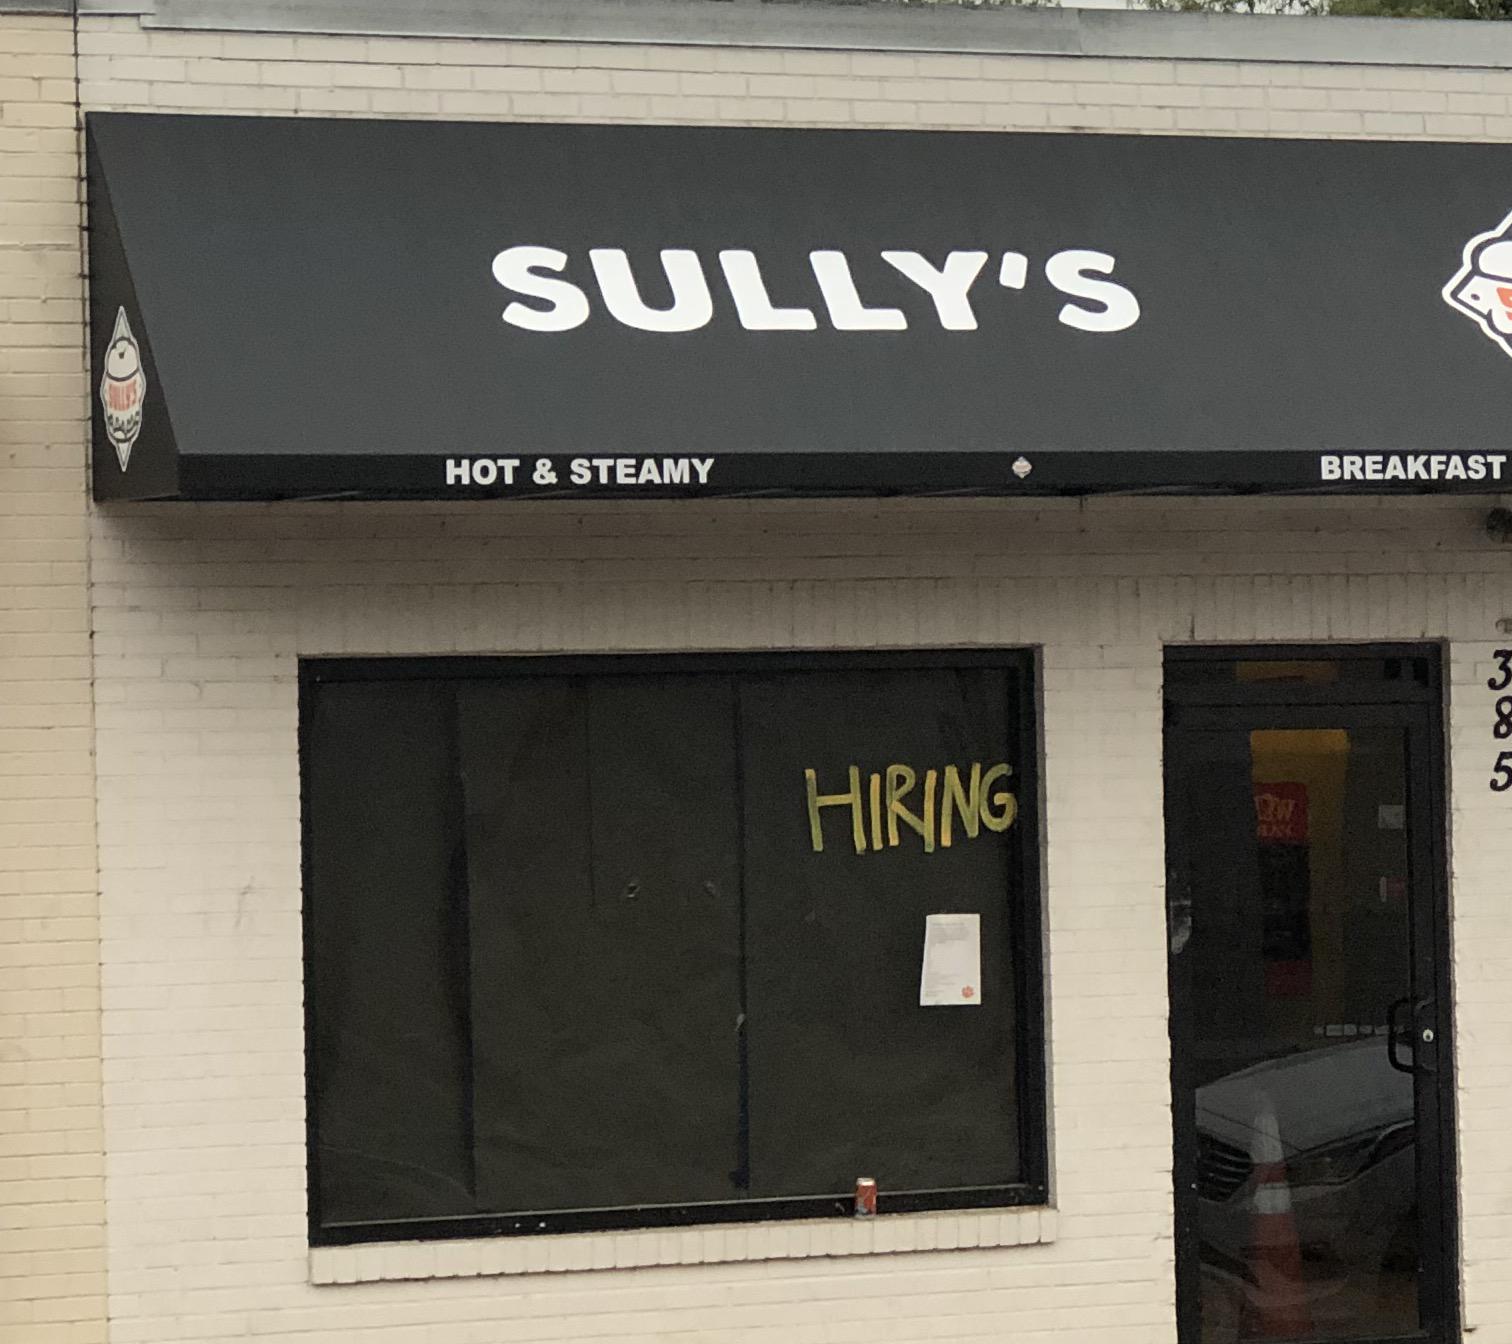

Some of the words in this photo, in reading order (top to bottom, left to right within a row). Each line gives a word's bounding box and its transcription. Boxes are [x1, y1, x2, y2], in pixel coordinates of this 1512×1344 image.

[491, 245, 1141, 333] SULLY'S
[445, 458, 520, 485] HOT
[532, 458, 558, 484] &
[570, 458, 715, 484] STEAMY
[1320, 455, 1507, 481] BREAKFAST
[804, 762, 1018, 854] HIRING
